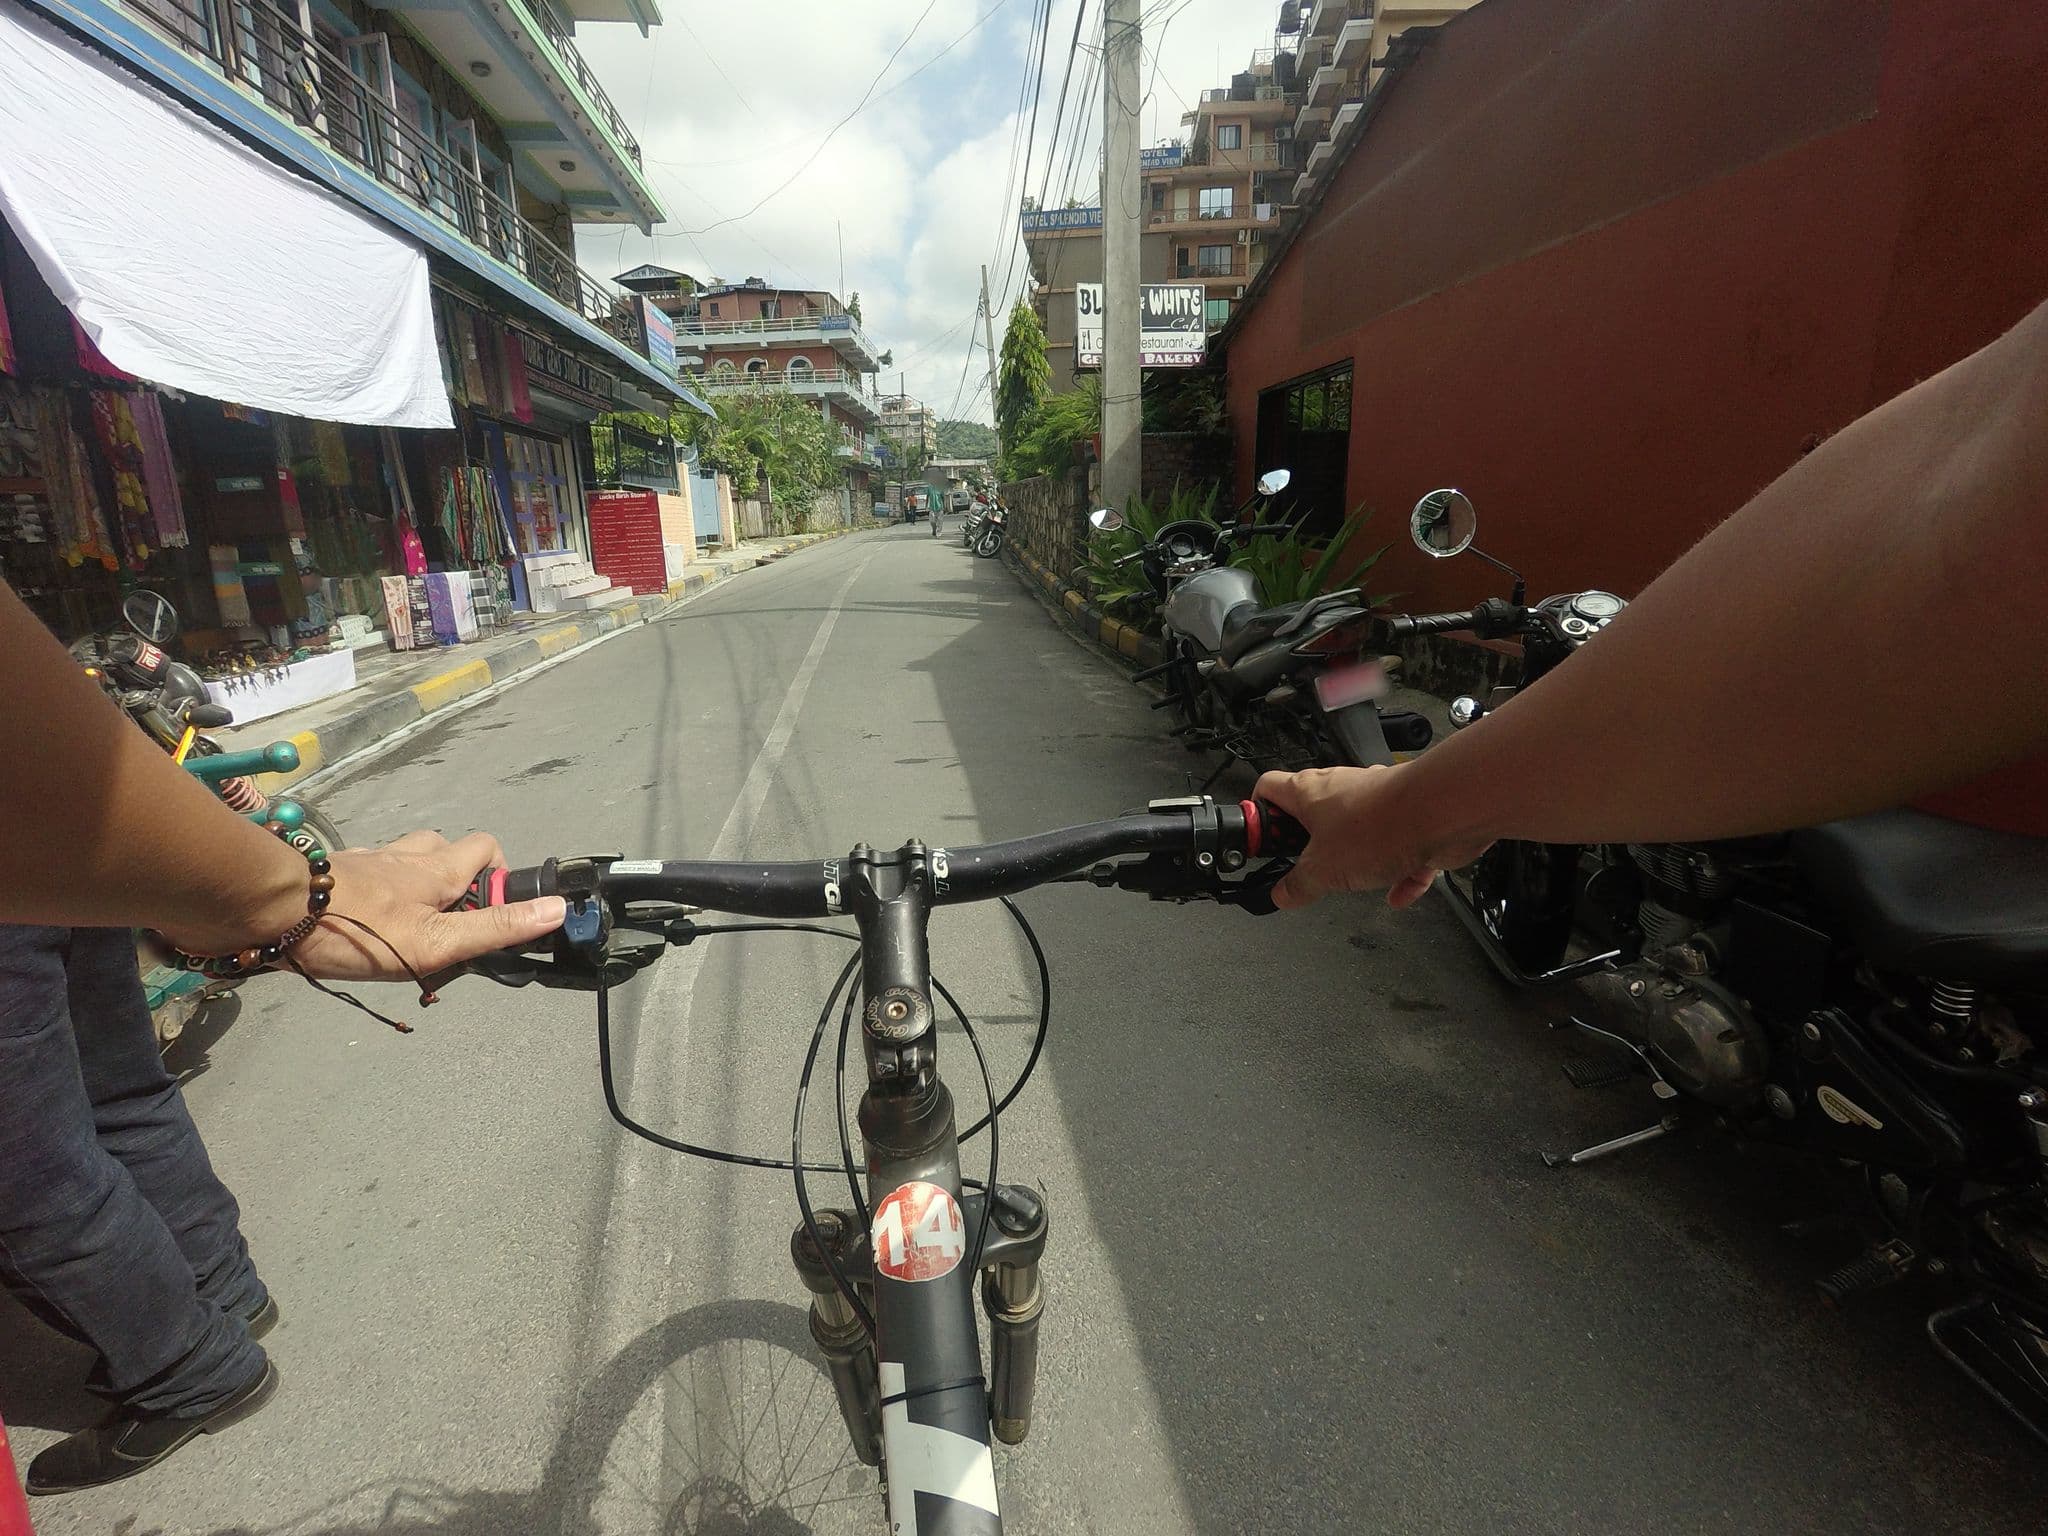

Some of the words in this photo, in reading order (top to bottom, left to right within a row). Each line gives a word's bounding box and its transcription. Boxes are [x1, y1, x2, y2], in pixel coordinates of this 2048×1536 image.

[1162, 157, 1179, 166] VIEW
[1023, 213, 1048, 227] HOTEL
[1089, 209, 1102, 223] VIE
[1149, 288, 1201, 316] WHITE
[1141, 337, 1184, 348] estaurant
[1144, 353, 1202, 364] BAKERY
[874, 1193, 964, 1267] 14
